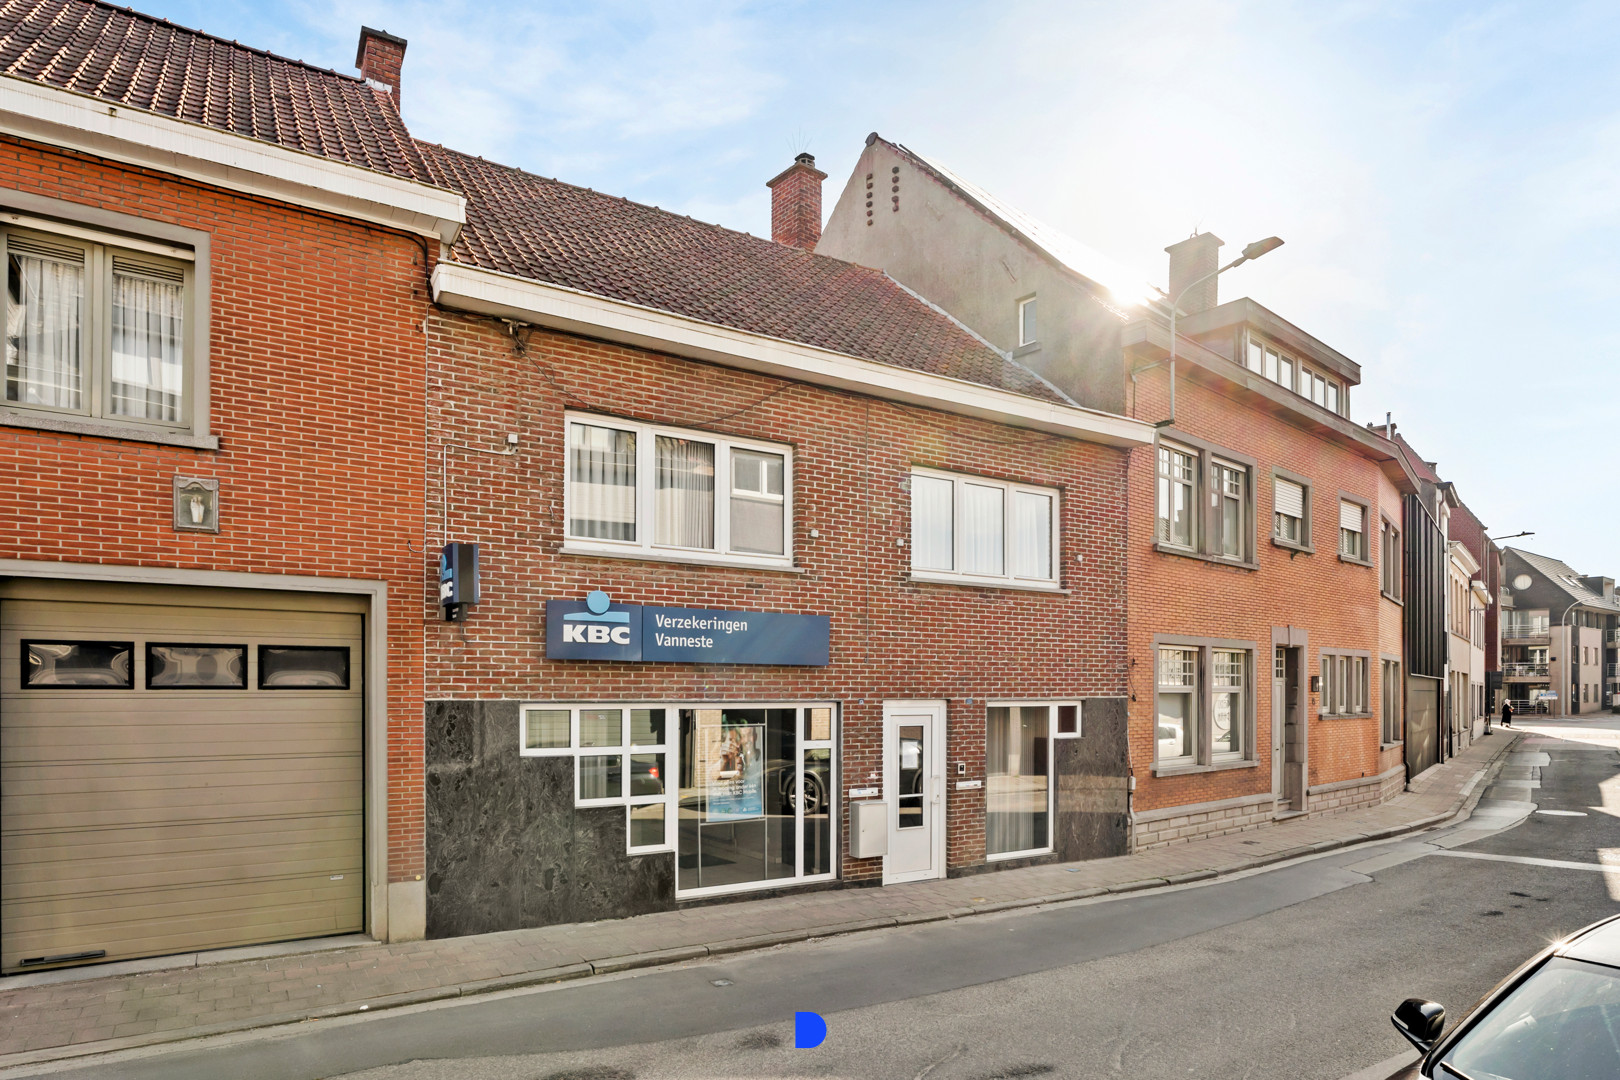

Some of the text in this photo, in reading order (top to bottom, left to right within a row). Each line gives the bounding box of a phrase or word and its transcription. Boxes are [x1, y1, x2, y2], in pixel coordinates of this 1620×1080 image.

[440, 581, 453, 601] BC
[655, 614, 748, 634] Verzekeringen
[563, 624, 630, 645] KBC
[655, 633, 714, 648] Vanneste
